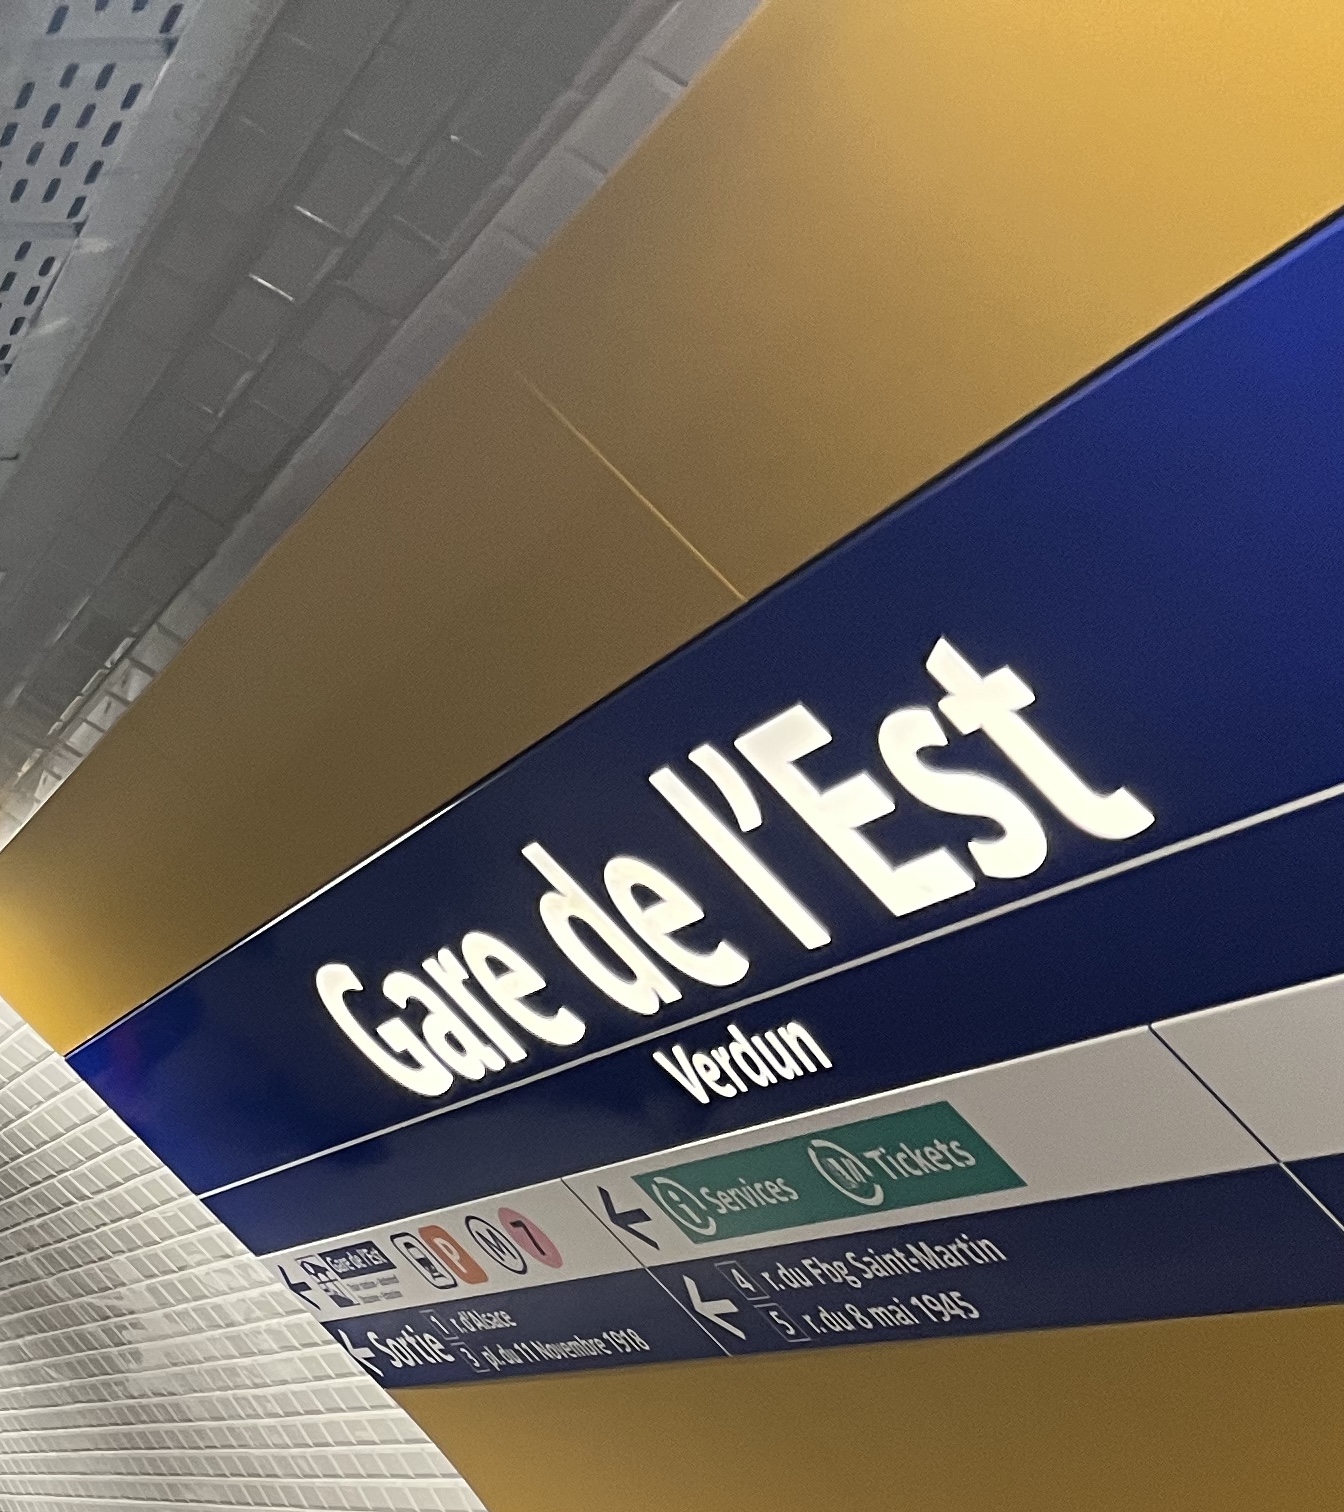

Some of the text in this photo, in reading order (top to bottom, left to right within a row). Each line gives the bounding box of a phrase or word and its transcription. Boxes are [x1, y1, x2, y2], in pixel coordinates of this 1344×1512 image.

[315, 635, 1156, 1097] Gare de l'Est
[653, 1019, 832, 1104] Verdun
[863, 1139, 976, 1181] Tickets
[699, 1176, 799, 1214] Services
[509, 1220, 546, 1256] 7
[325, 1256, 355, 1273] Gare
[346, 1251, 367, 1269] de
[731, 1269, 756, 1292] 4
[776, 1261, 805, 1289] du
[800, 1255, 862, 1288] Fbg
[847, 1233, 1007, 1281] Saint-Martin
[430, 1315, 450, 1334] 1
[458, 1310, 517, 1332] d'Alsace
[768, 1310, 796, 1335] 5
[816, 1305, 853, 1333] du
[848, 1301, 874, 1330] 8
[866, 1298, 919, 1329] mai
[911, 1290, 980, 1324] 1945
[367, 1324, 455, 1368] Sortie
[460, 1347, 480, 1367] 3
[496, 1344, 523, 1364] du
[514, 1343, 540, 1362] 11
[529, 1335, 612, 1359] Novembre
[603, 1328, 650, 1353] 1918
